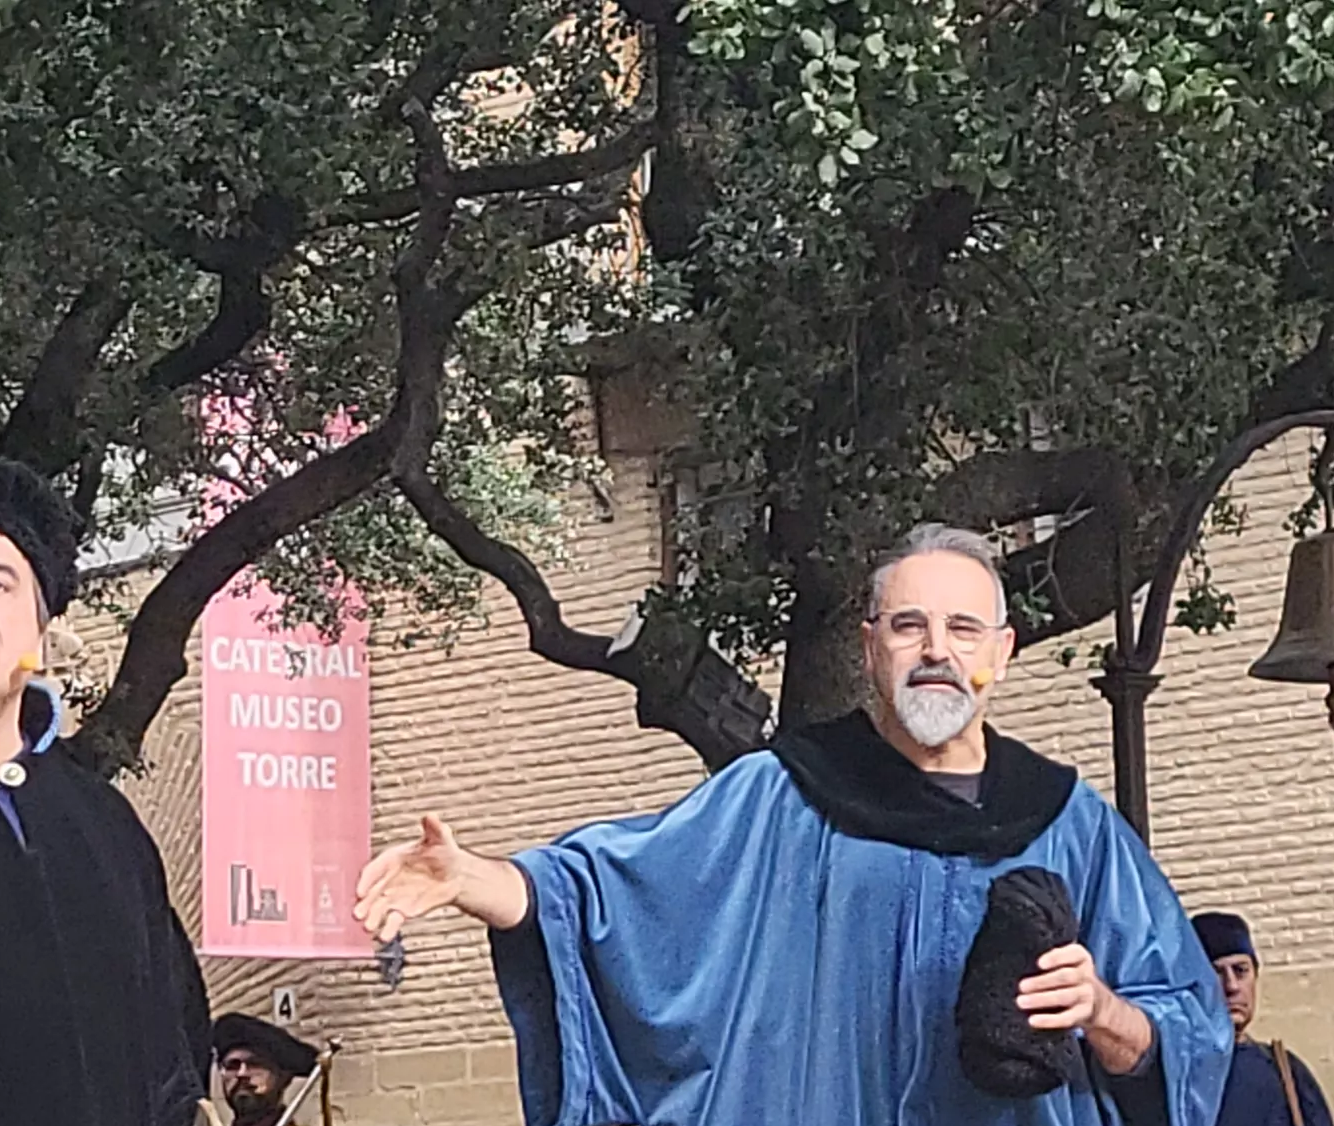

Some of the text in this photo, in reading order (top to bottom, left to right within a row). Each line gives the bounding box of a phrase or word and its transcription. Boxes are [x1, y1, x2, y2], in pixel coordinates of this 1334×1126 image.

[230, 692, 343, 732] MUSEO
[236, 751, 338, 790] TORRE
[279, 991, 292, 1020] 4
